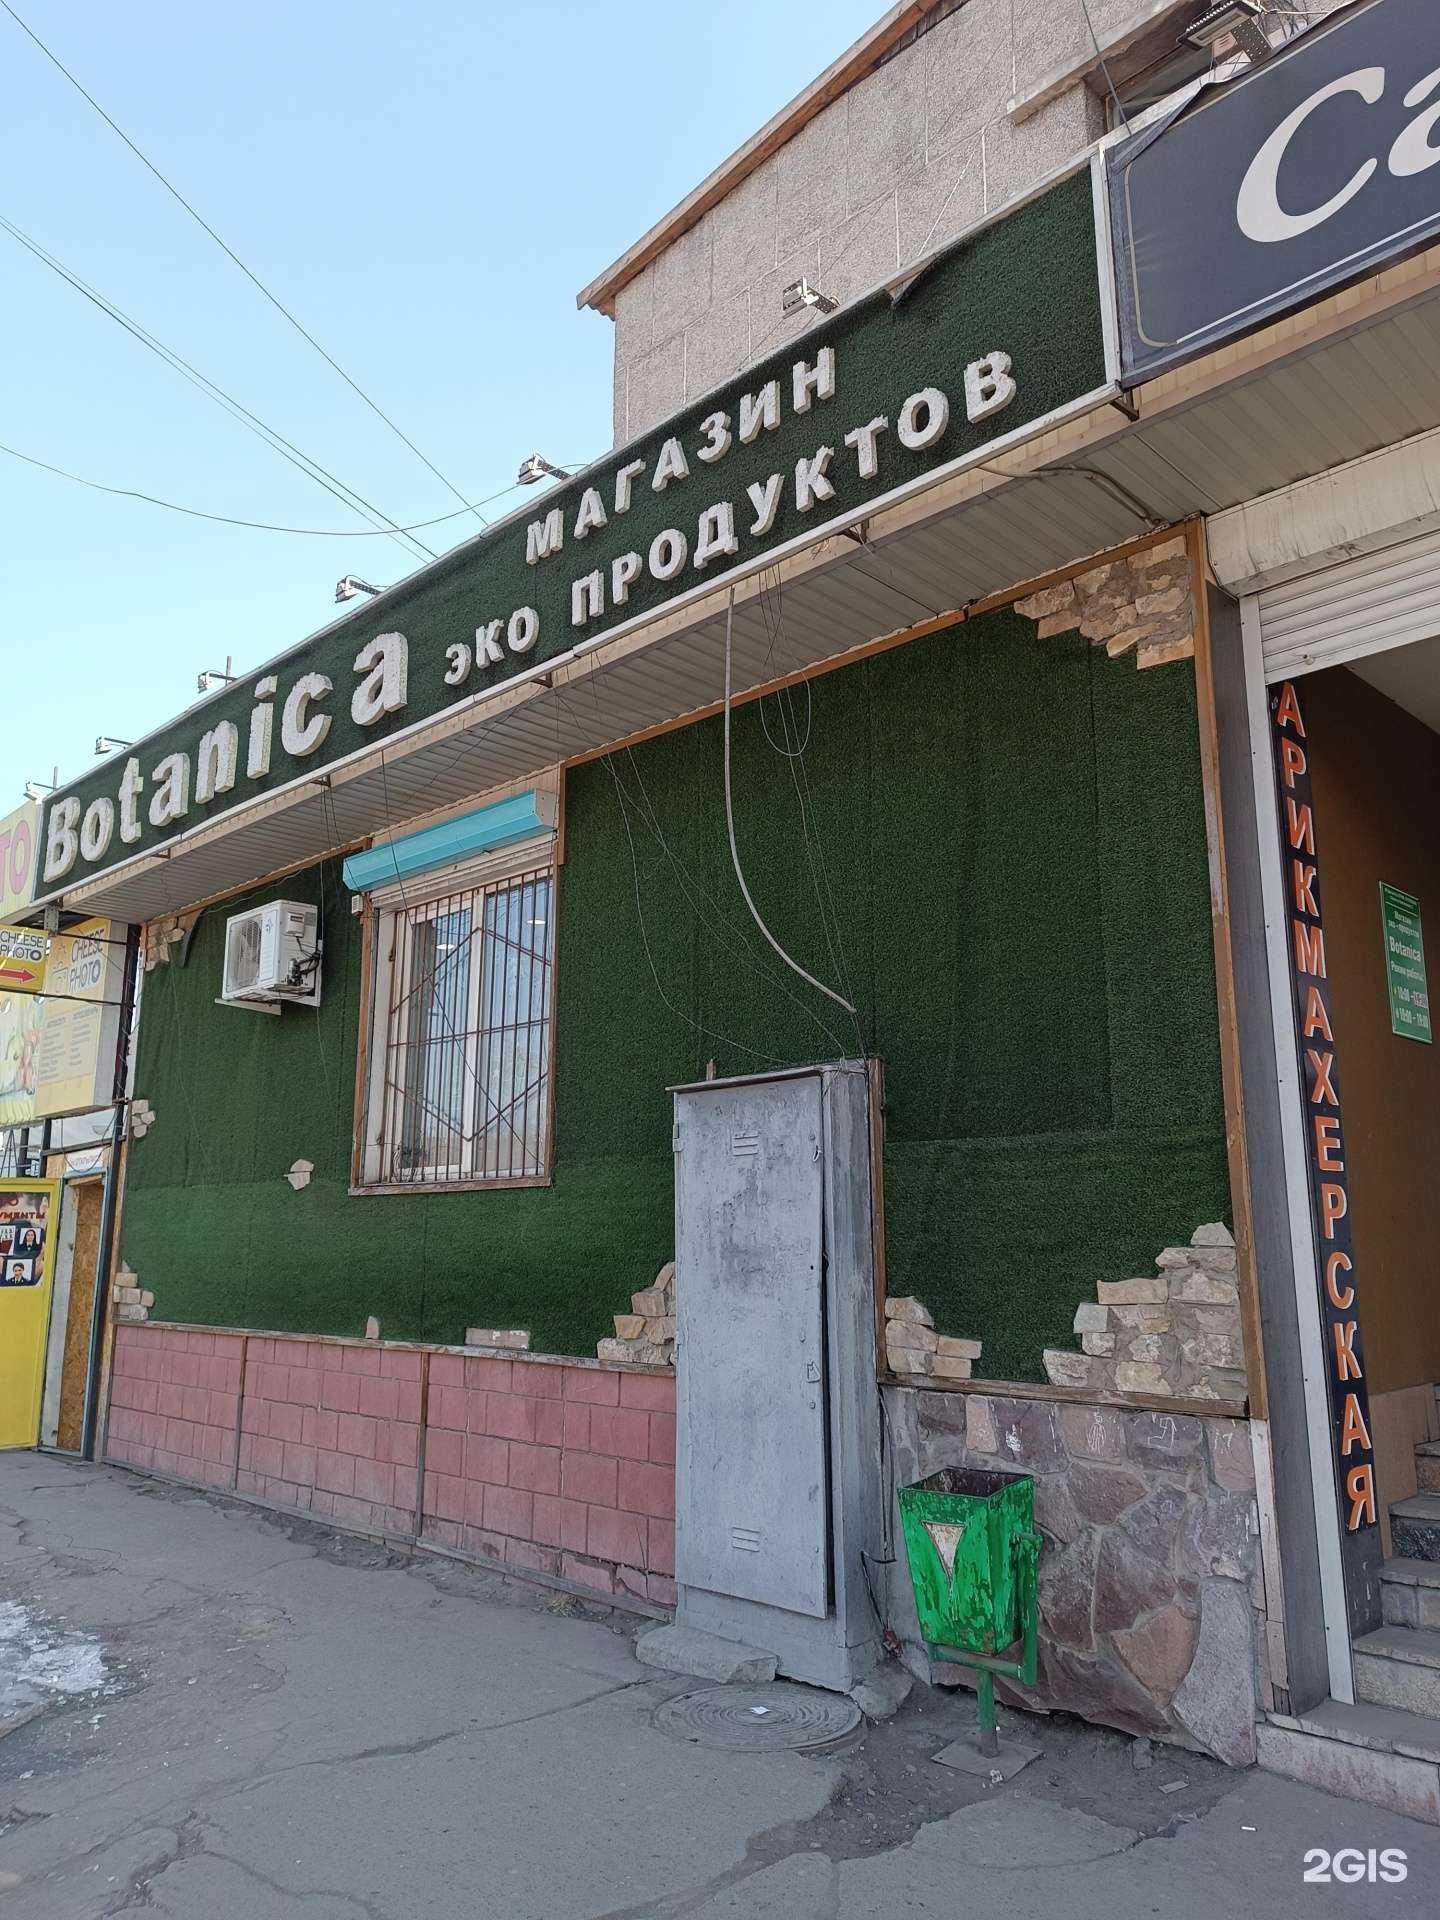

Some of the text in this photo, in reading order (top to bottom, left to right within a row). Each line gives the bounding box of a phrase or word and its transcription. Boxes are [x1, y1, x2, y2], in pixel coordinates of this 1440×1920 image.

[444, 350, 1018, 687] ЭКО ПРОДУКТОВ
[526, 346, 836, 565] МАГАЗИН
[43, 632, 409, 884] Botanica
[1389, 935, 1421, 962] Botanica
